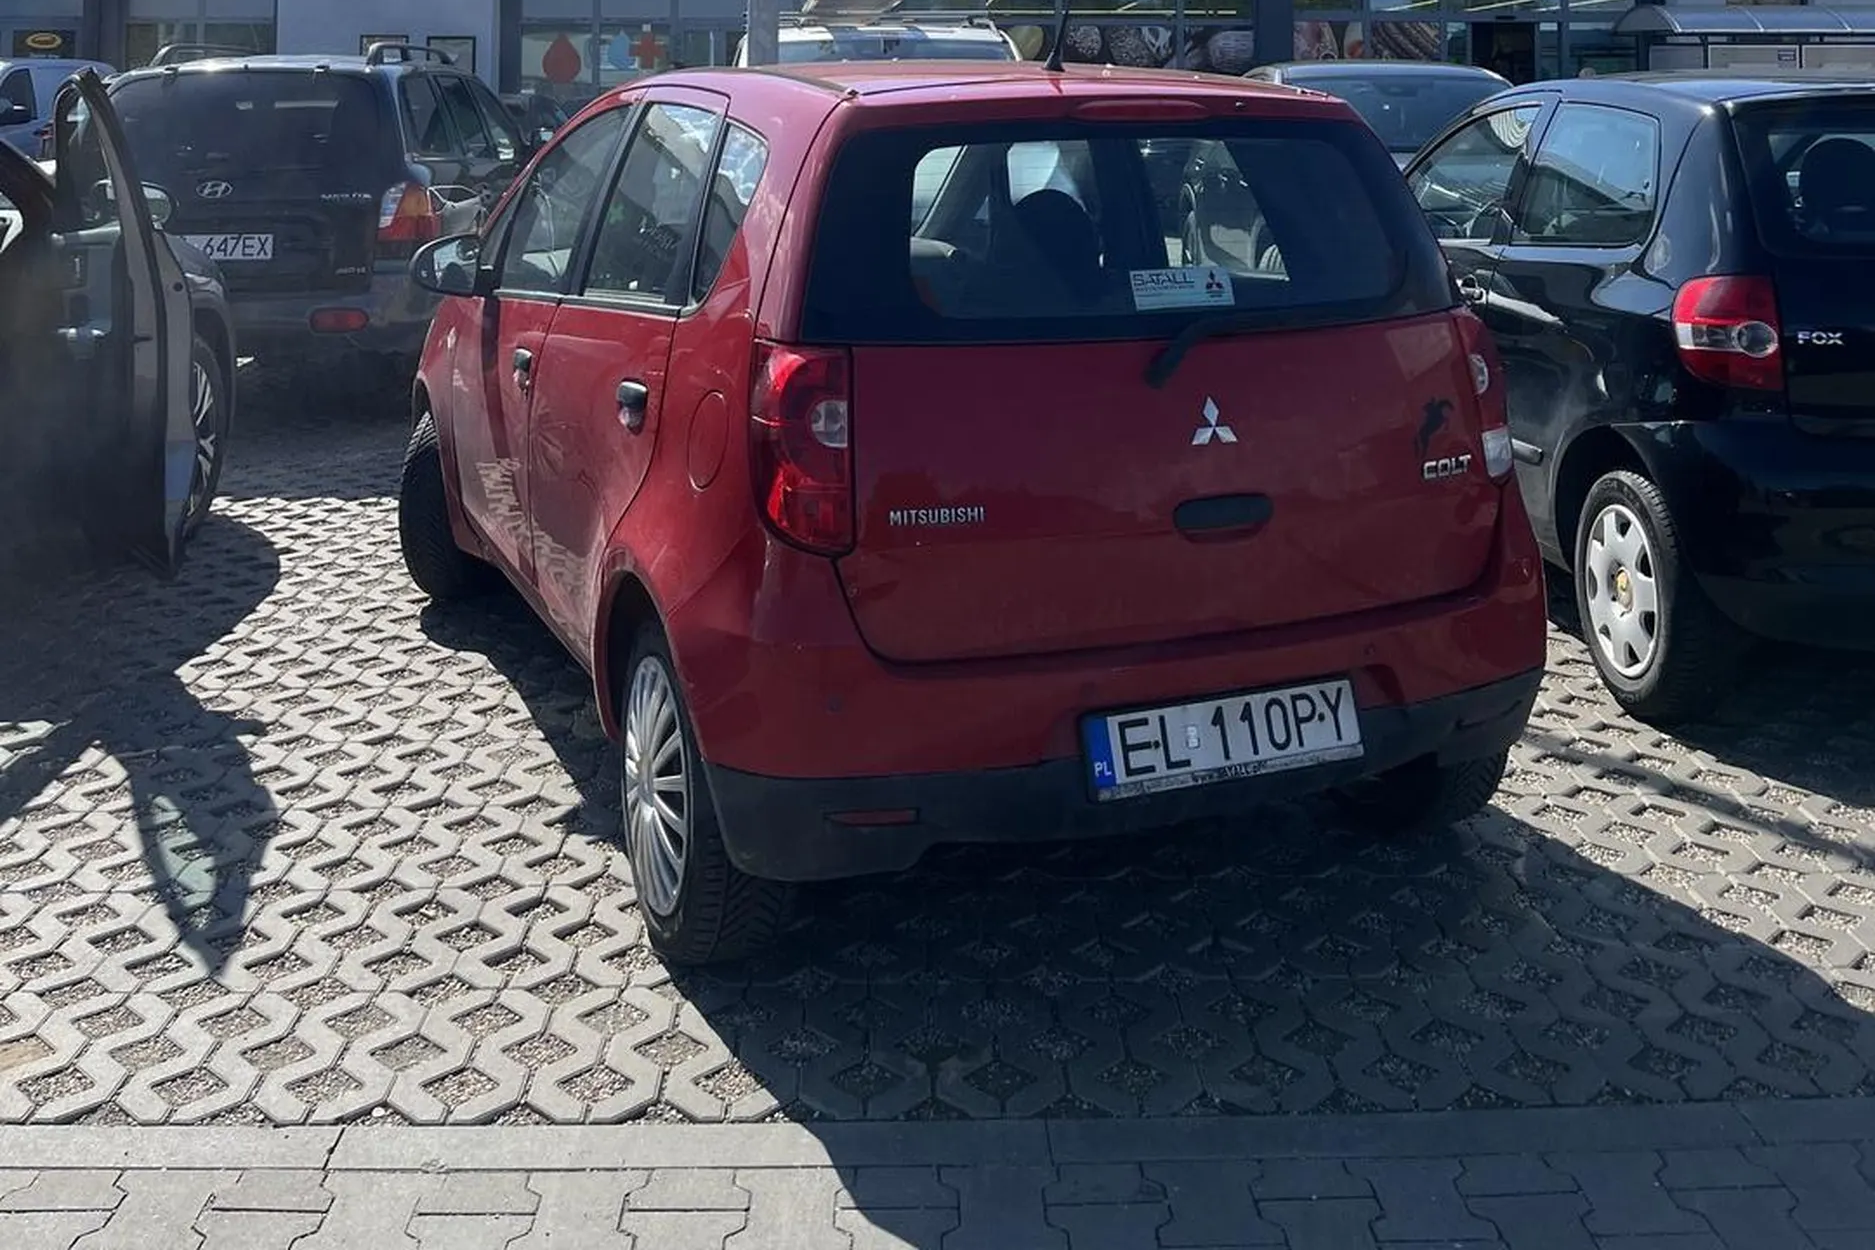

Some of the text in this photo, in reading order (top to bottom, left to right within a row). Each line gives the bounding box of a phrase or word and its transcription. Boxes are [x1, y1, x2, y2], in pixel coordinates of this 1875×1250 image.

[1797, 331, 1844, 345] FOX
[1423, 454, 1472, 480] COLT
[889, 506, 985, 527] MITSUBISHI
[1117, 686, 1343, 778] EL 110PY
[1093, 760, 1113, 777] PL
